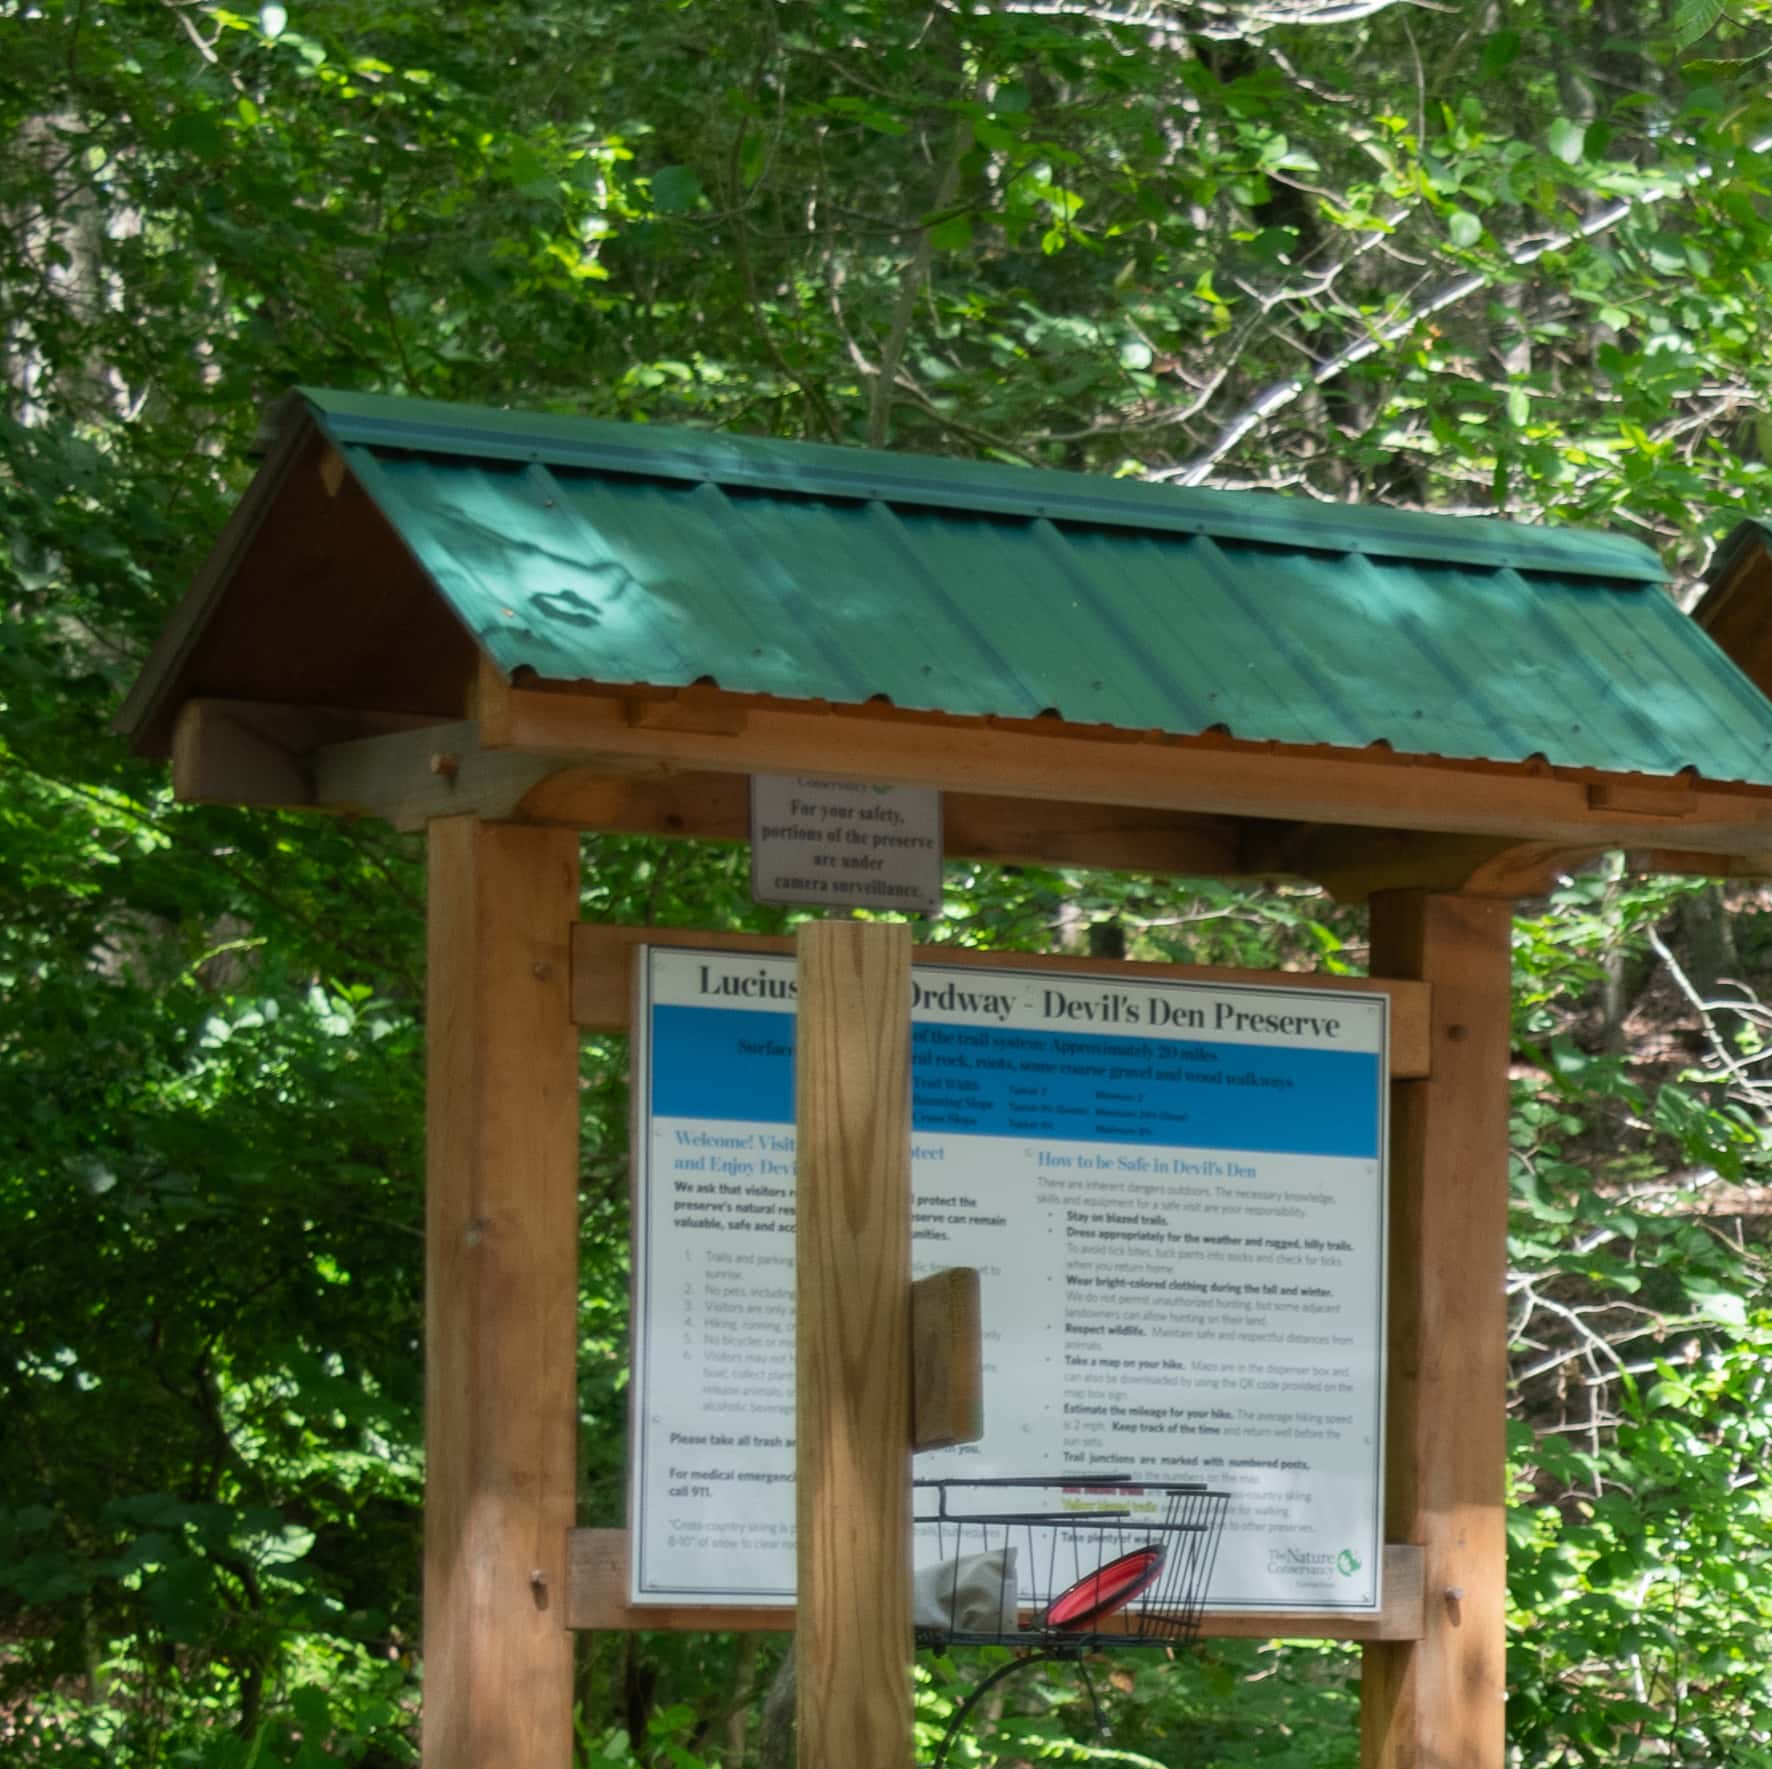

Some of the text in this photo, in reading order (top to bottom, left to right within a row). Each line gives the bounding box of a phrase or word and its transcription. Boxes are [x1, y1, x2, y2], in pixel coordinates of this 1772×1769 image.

[791, 800, 904, 826] For your safety,
[762, 825, 935, 849] portions of the preserve
[814, 855, 884, 871] are under
[775, 877, 924, 898] camera surveillance.
[1043, 990, 1139, 1024] Devil's
[1149, 1000, 1205, 1029] Den
[1214, 1002, 1341, 1038] Preserve
[674, 1130, 752, 1150] Welcome!
[674, 1156, 754, 1177] and Enjoy
[1038, 1151, 1257, 1178] How to be Safe in Devil's Den
[672, 1180, 786, 1198] We ask that visitors
[916, 1194, 978, 1209] protect the
[674, 1199, 1006, 1226] preserve's natural can remain
[1066, 1211, 1168, 1226] Stay on blazed trails.
[673, 1217, 775, 1232] valuable, safe and
[1066, 1226, 1354, 1253] Dress appropriately for the weather and rugged, hilly trails.
[1066, 1275, 1334, 1297] Wear bright-colored clothing during the fall and winter.
[1064, 1322, 1146, 1338] Respect wildlife.
[1064, 1355, 1186, 1373] Take a map on your hike.
[1064, 1404, 1234, 1422] Estimate the mileage for your hike.
[1112, 1421, 1220, 1435] Keep track of the time
[669, 1432, 782, 1446] Please take all trash
[1064, 1452, 1086, 1463] Trail
[1088, 1452, 1136, 1467] junctions
[1140, 1456, 1156, 1465] are
[1160, 1454, 1200, 1466] marked
[1202, 1455, 1224, 1467] with
[1228, 1456, 1280, 1468] numbered
[669, 1467, 734, 1480] For medical
[669, 1485, 712, 1497] call 911.
[1287, 1547, 1336, 1564] Nature
[1267, 1562, 1334, 1580] Conservancy
